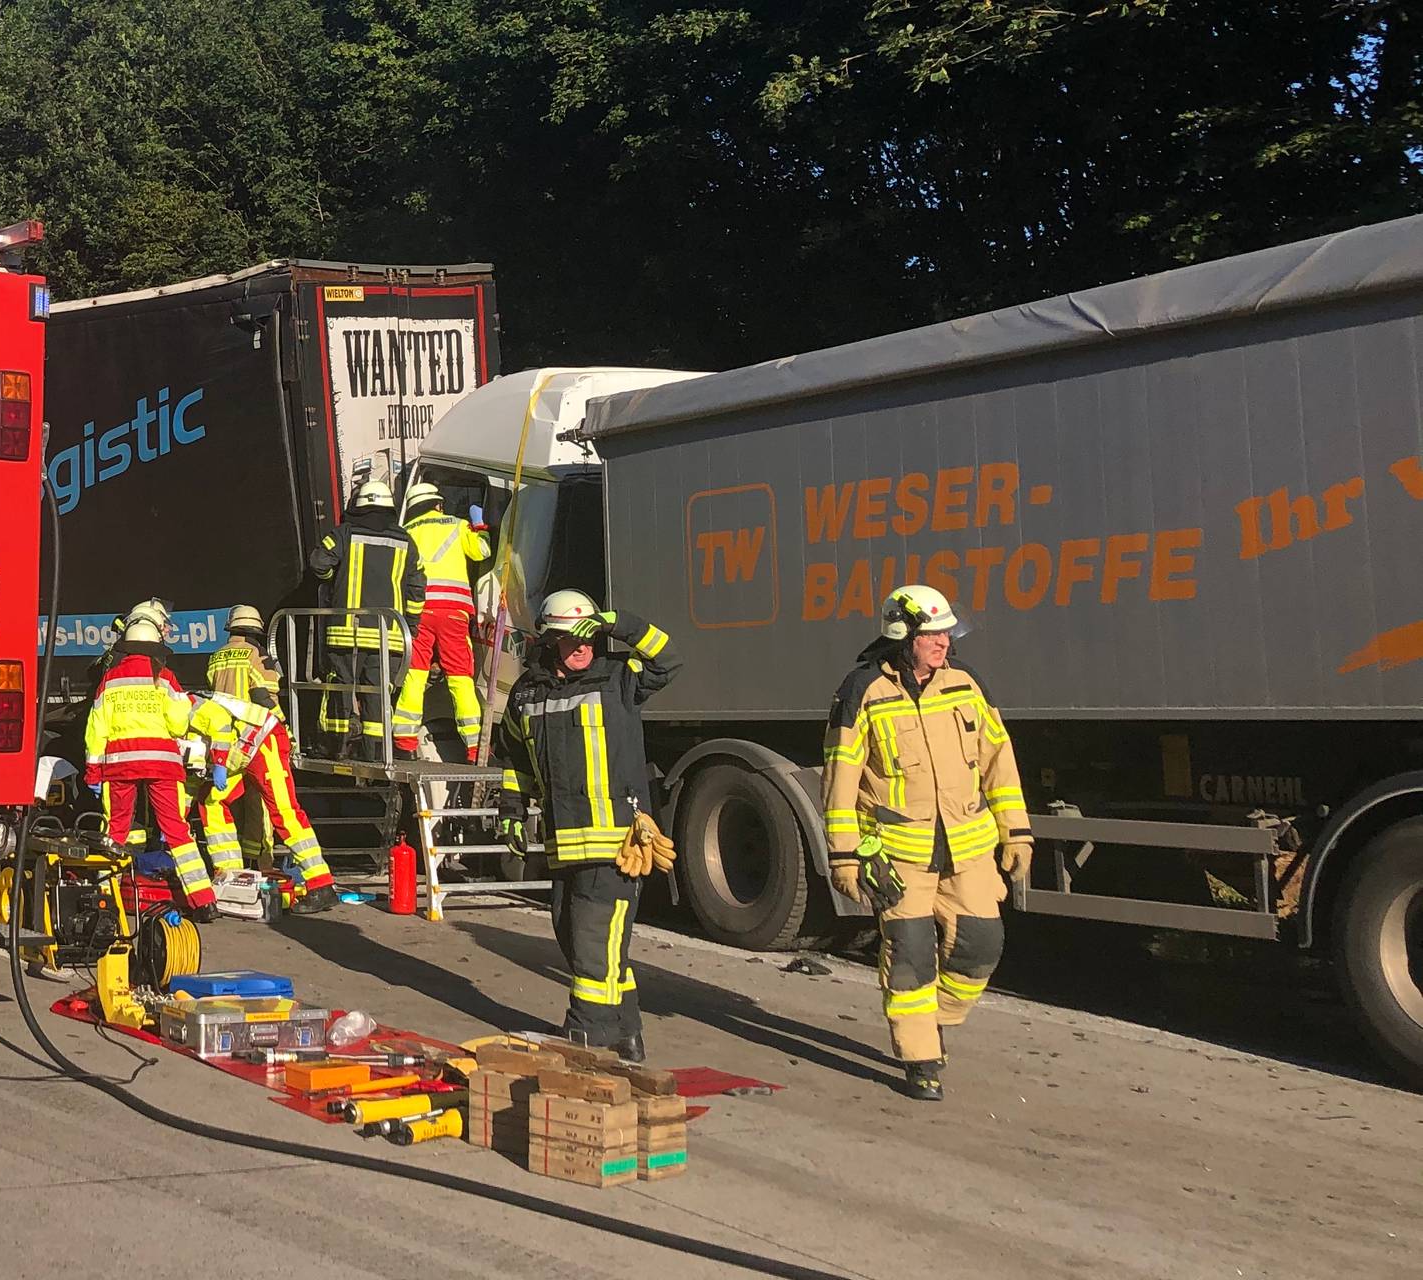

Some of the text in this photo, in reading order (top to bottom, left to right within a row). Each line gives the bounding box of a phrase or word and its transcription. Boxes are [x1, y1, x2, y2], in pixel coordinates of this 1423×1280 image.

[325, 288, 355, 299] WIELTON
[342, 329, 465, 398] WANTED
[40, 386, 206, 516] gistic
[387, 404, 434, 440] EUROPE
[803, 462, 1053, 545] WESER-
[1234, 476, 1366, 560] Ihr
[695, 526, 765, 586] TW
[802, 527, 1203, 621] BAUSTOFFE
[1199, 773, 1306, 805] CARNEHL
